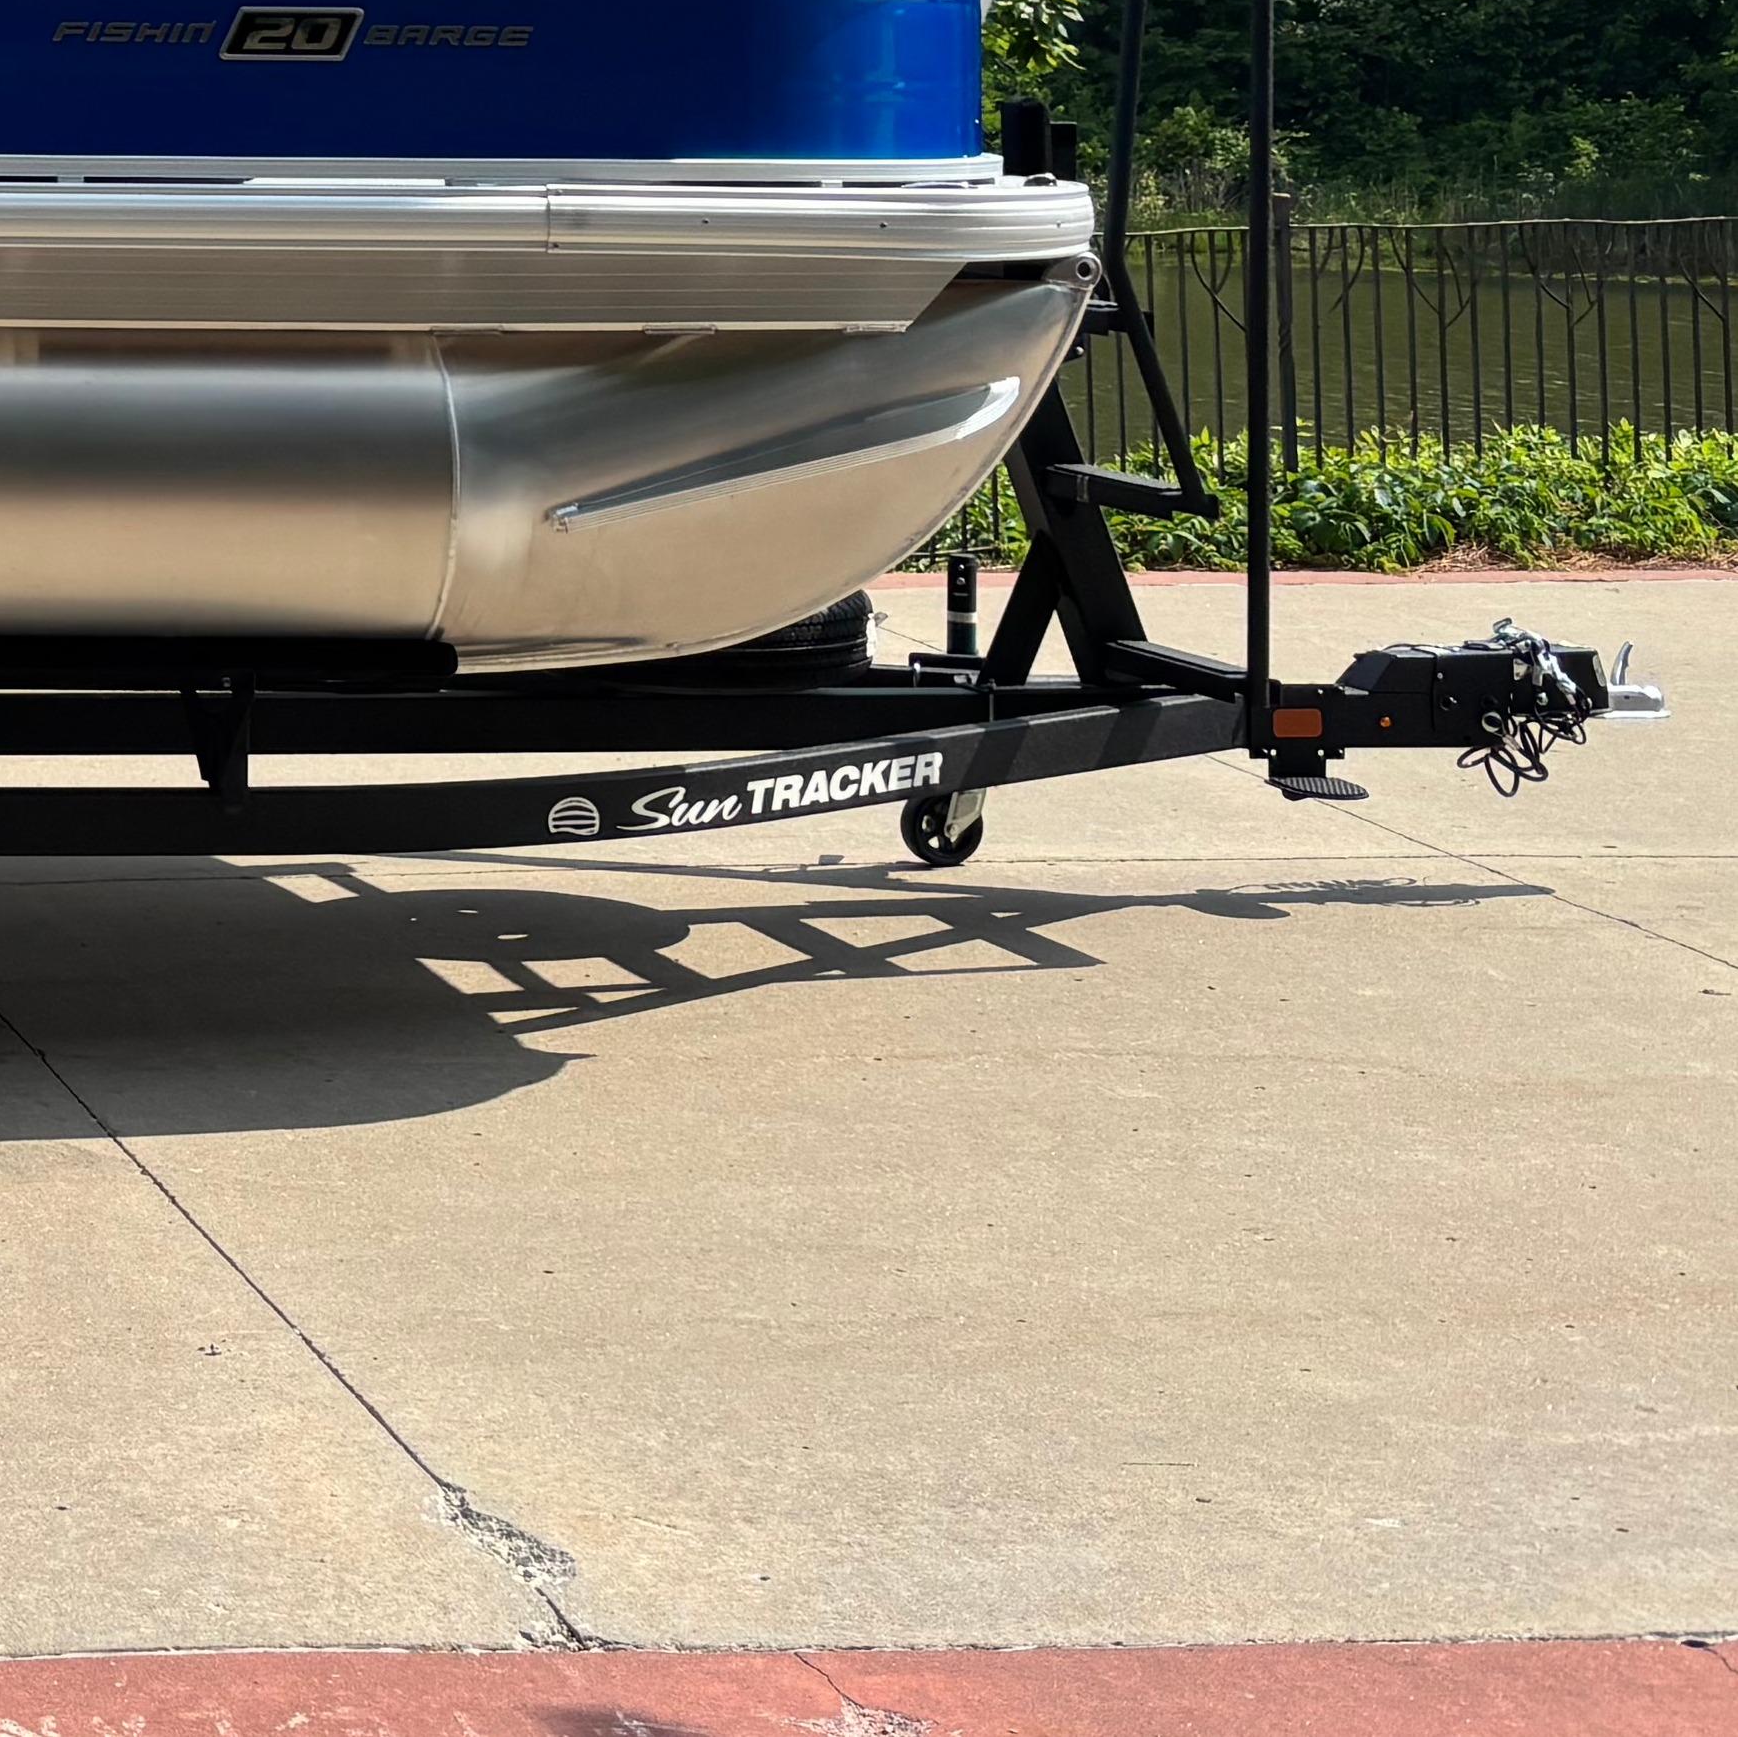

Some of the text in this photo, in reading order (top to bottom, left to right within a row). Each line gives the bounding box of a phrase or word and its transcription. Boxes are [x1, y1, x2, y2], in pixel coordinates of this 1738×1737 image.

[242, 17, 342, 51] 20
[363, 24, 534, 47] BARGE
[616, 751, 943, 831] Sun TRACKER
